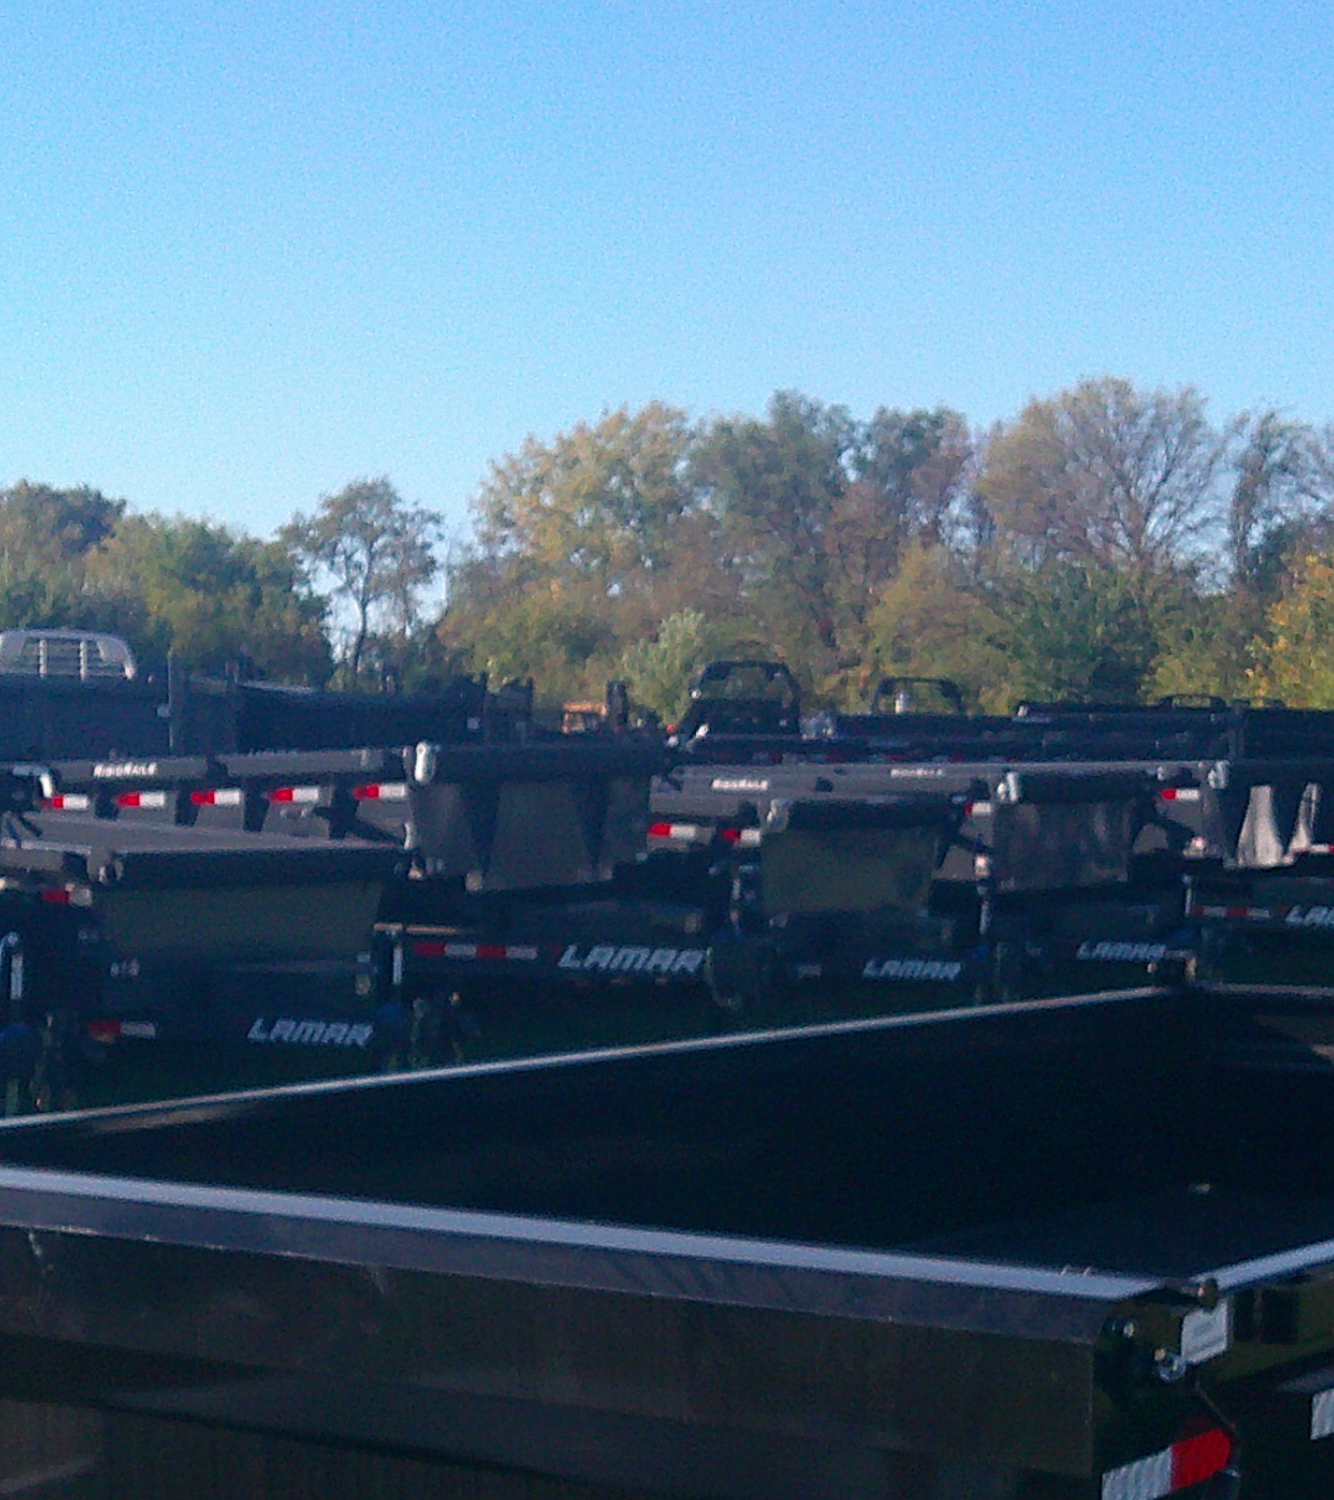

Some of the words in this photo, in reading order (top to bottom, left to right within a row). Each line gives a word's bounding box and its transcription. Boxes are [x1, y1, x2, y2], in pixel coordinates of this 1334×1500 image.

[558, 944, 704, 973] LAMAR
[861, 959, 961, 982] LAMAR
[246, 1018, 374, 1047] LAMAR
